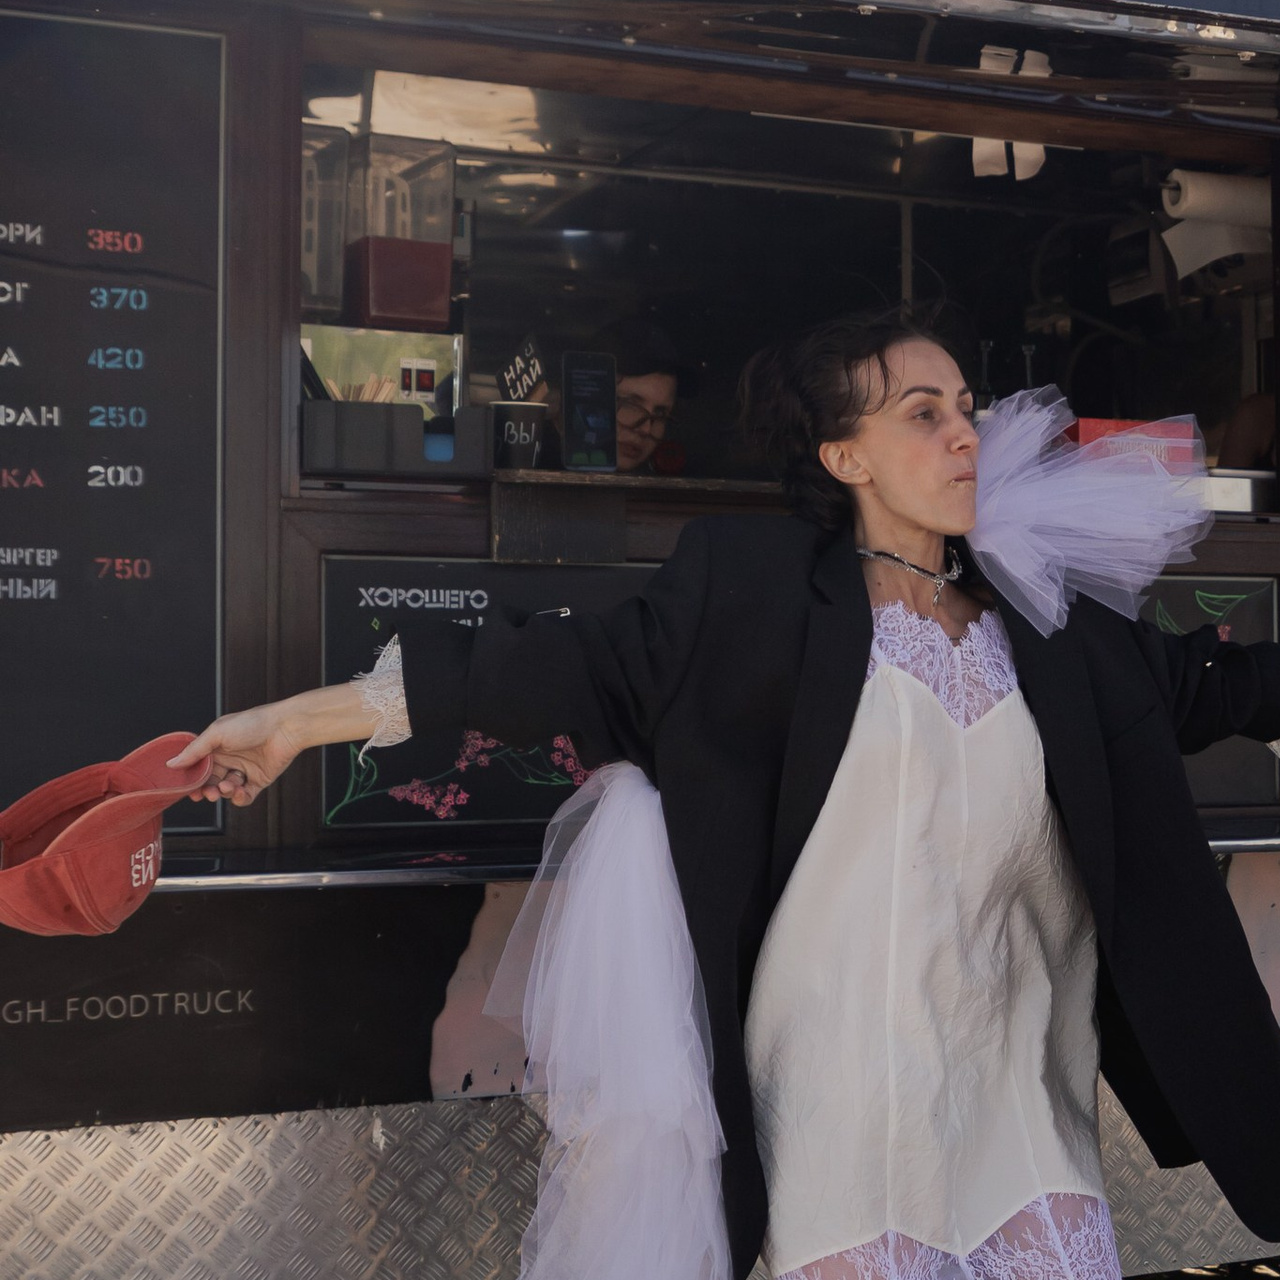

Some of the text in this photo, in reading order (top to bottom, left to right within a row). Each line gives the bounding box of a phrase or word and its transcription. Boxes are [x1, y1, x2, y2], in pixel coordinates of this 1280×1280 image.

[87, 228, 144, 253] 350
[89, 286, 148, 310] 370
[87, 346, 144, 370] 420
[504, 355, 525, 387] НА
[509, 357, 542, 400] ЧАЙ
[88, 405, 147, 428] 250
[87, 465, 144, 487] 200
[93, 557, 151, 579] 750
[358, 587, 489, 609] ХОРОШЕГО
[2, 989, 254, 1023] GH_FOODTRUCK
